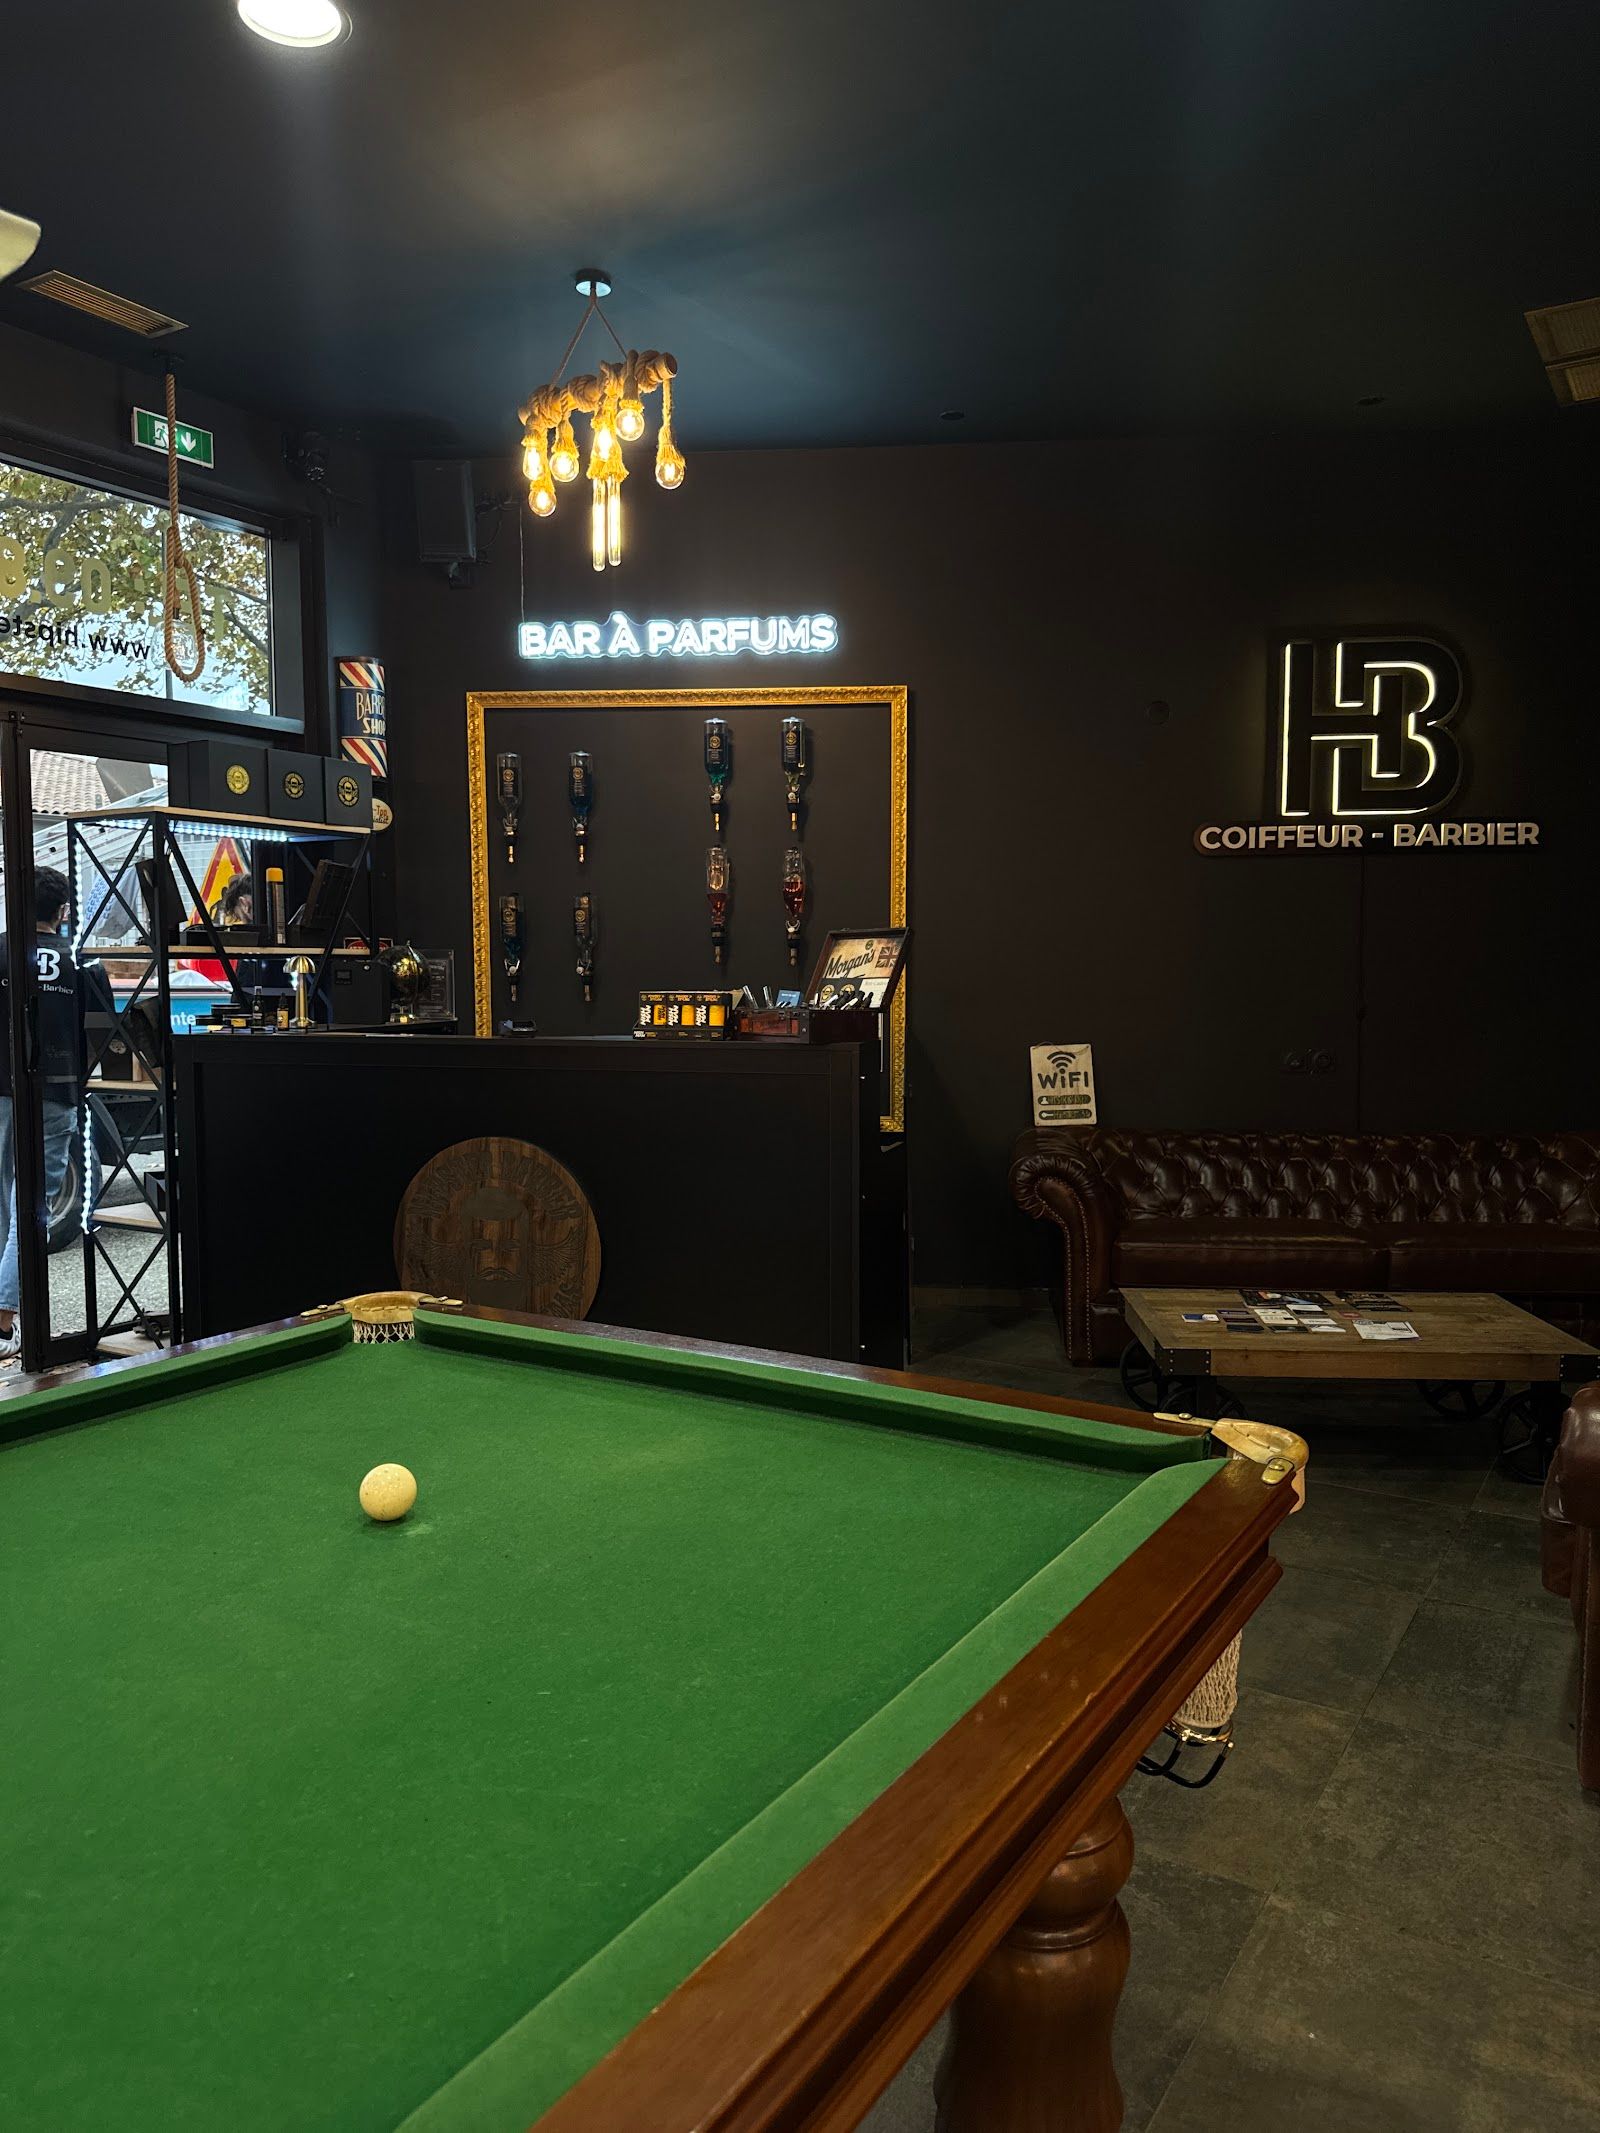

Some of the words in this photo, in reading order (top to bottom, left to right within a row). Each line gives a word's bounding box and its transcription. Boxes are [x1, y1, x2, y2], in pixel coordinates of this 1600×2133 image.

[522, 623, 601, 654] BAR
[608, 613, 640, 653] À
[648, 614, 835, 653] PARFUMS
[1199, 825, 1364, 849] COIFFEUR
[1393, 822, 1540, 847] BARBIER
[825, 949, 876, 979] Morgan's
